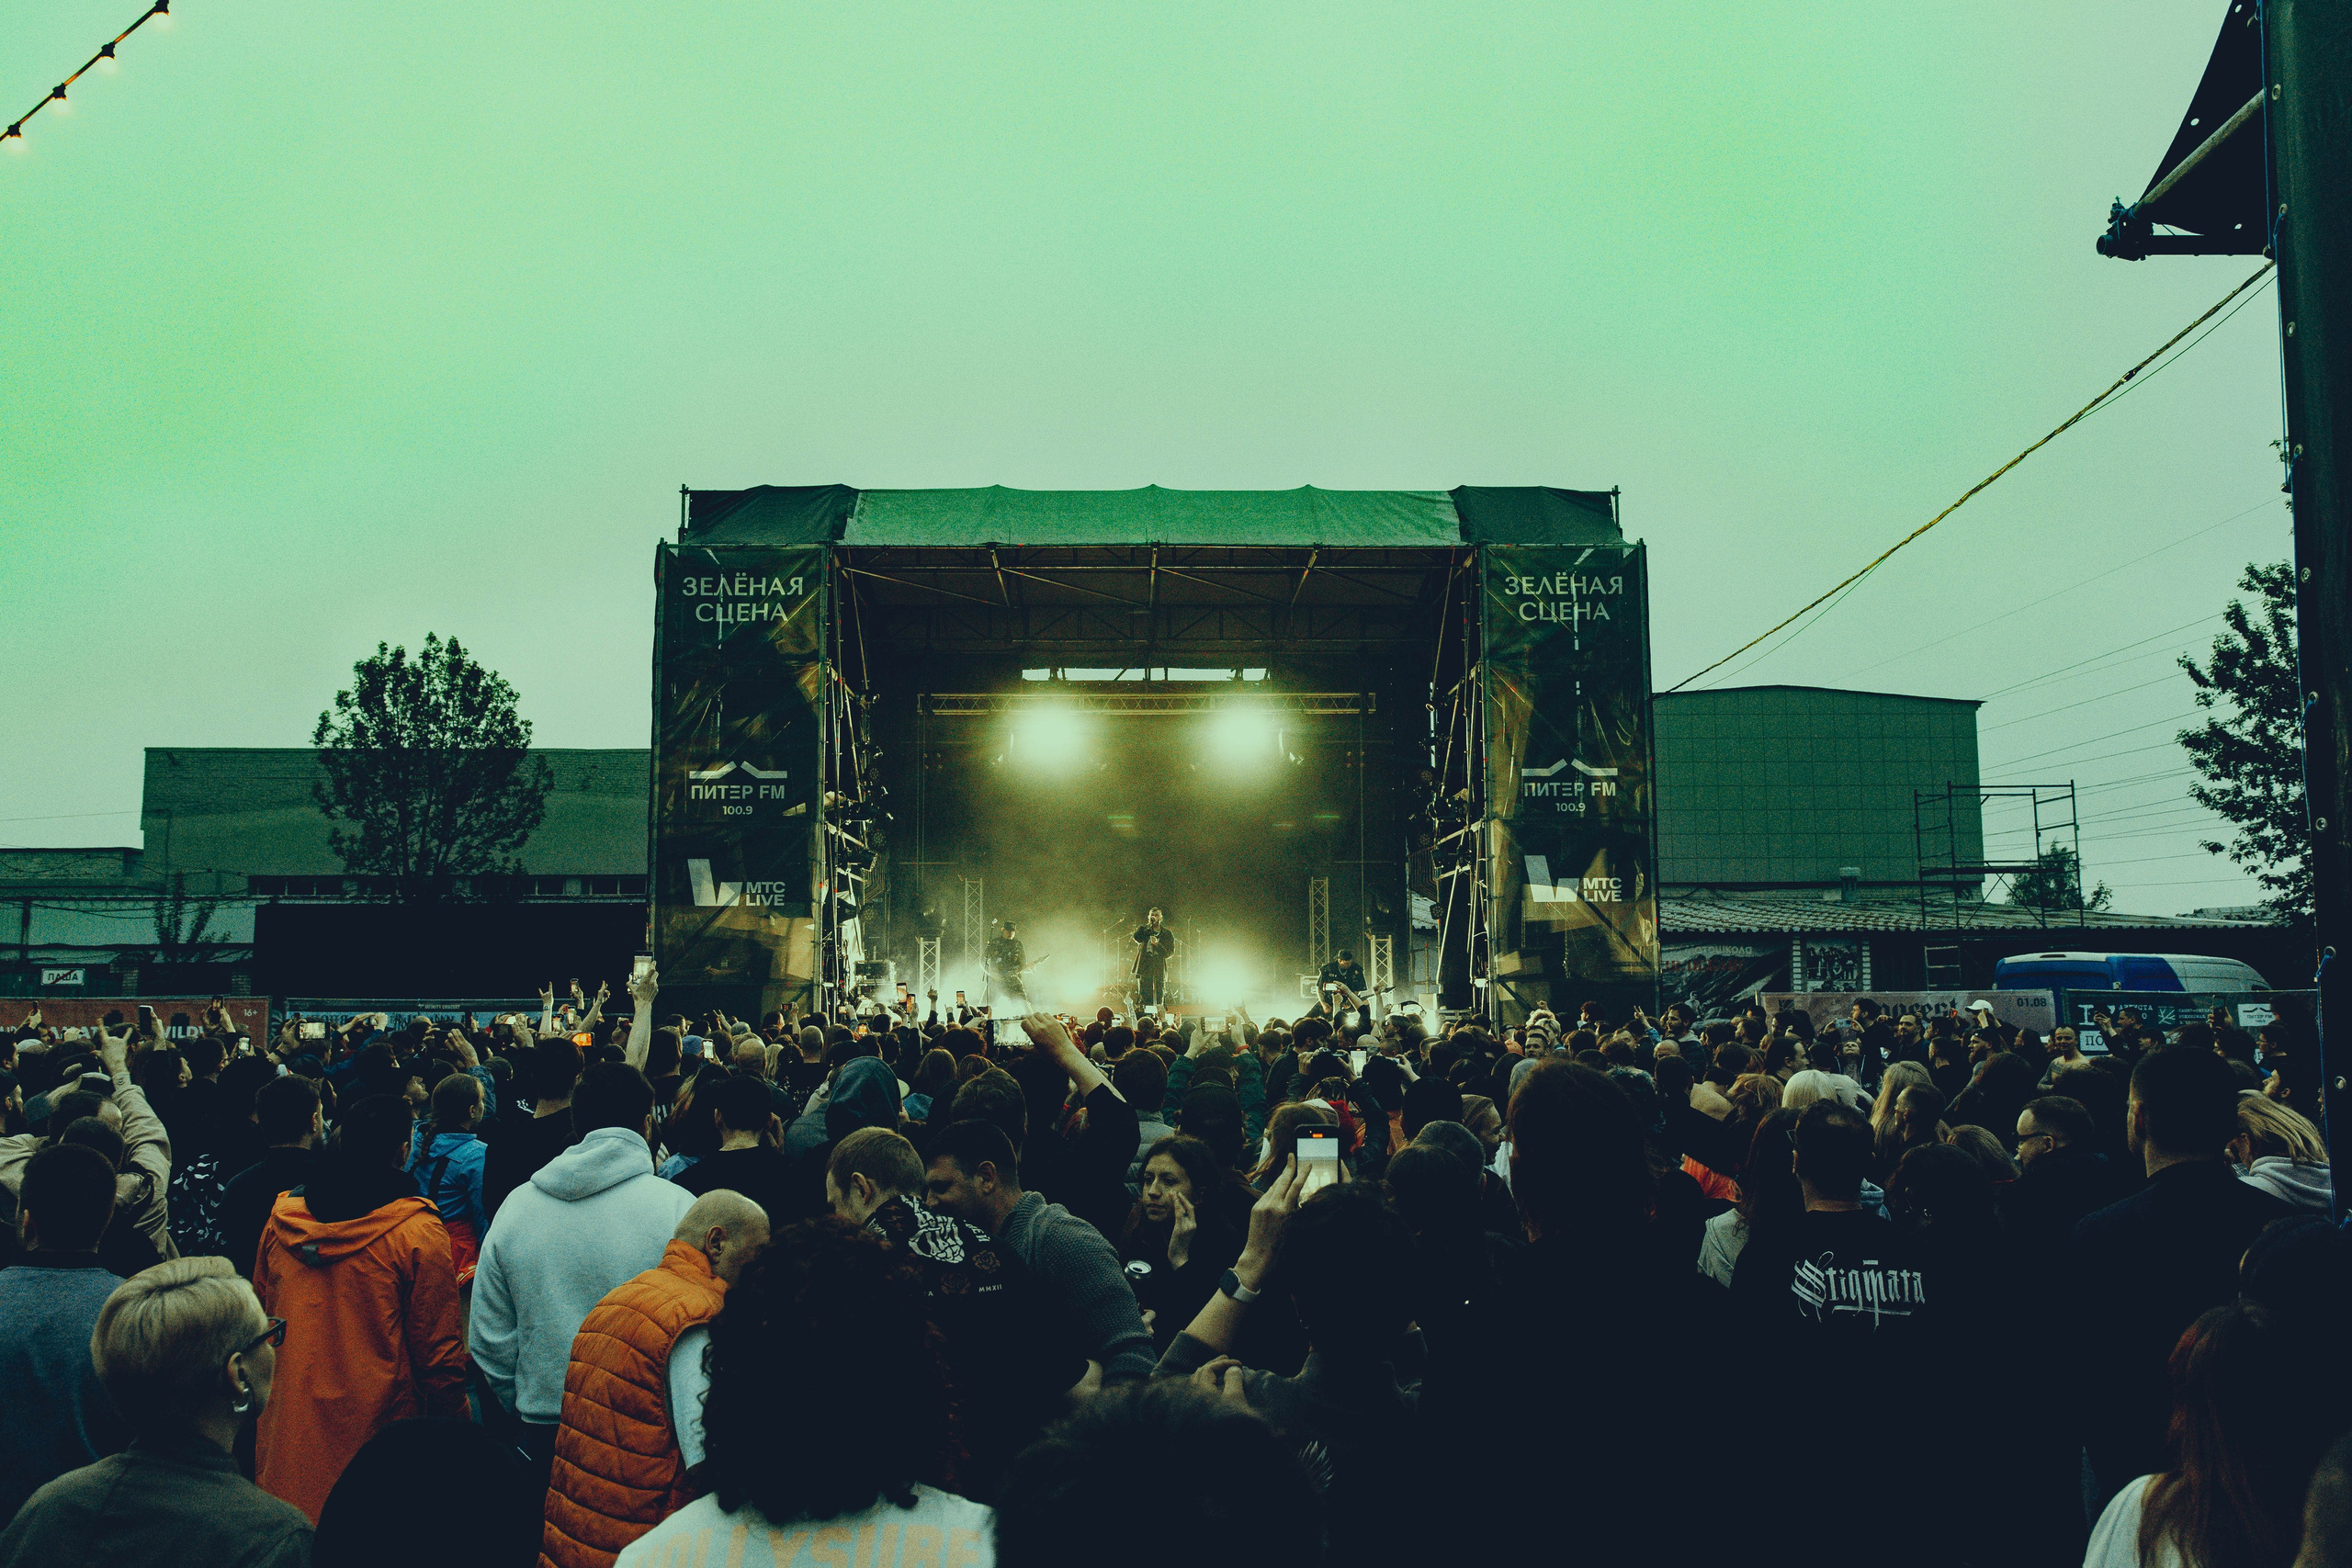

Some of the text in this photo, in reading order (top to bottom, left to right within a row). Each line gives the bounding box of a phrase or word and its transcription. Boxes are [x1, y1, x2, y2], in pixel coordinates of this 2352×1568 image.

[682, 572, 804, 596] ЗЕЛЁНАЯ
[1504, 571, 1623, 595] ЗЕЛЁНАЯ
[695, 603, 788, 624] СЦЕНА
[1519, 602, 1611, 623] СЦЕНА
[691, 784, 786, 799] ПИТЕР FM
[1524, 782, 1616, 797] ПИТЕР FM
[722, 806, 753, 815] 100.9
[1555, 803, 1586, 812] 100.9
[745, 894, 786, 907] LIVE
[1584, 890, 1623, 902] LIVE
[48, 973, 78, 981] ПАША
[2017, 998, 2047, 1008] 01.08
[243, 1009, 258, 1017] 16+
[978, 1283, 1002, 1293] MMXII
[1791, 1250, 1926, 1333] Stigmata
